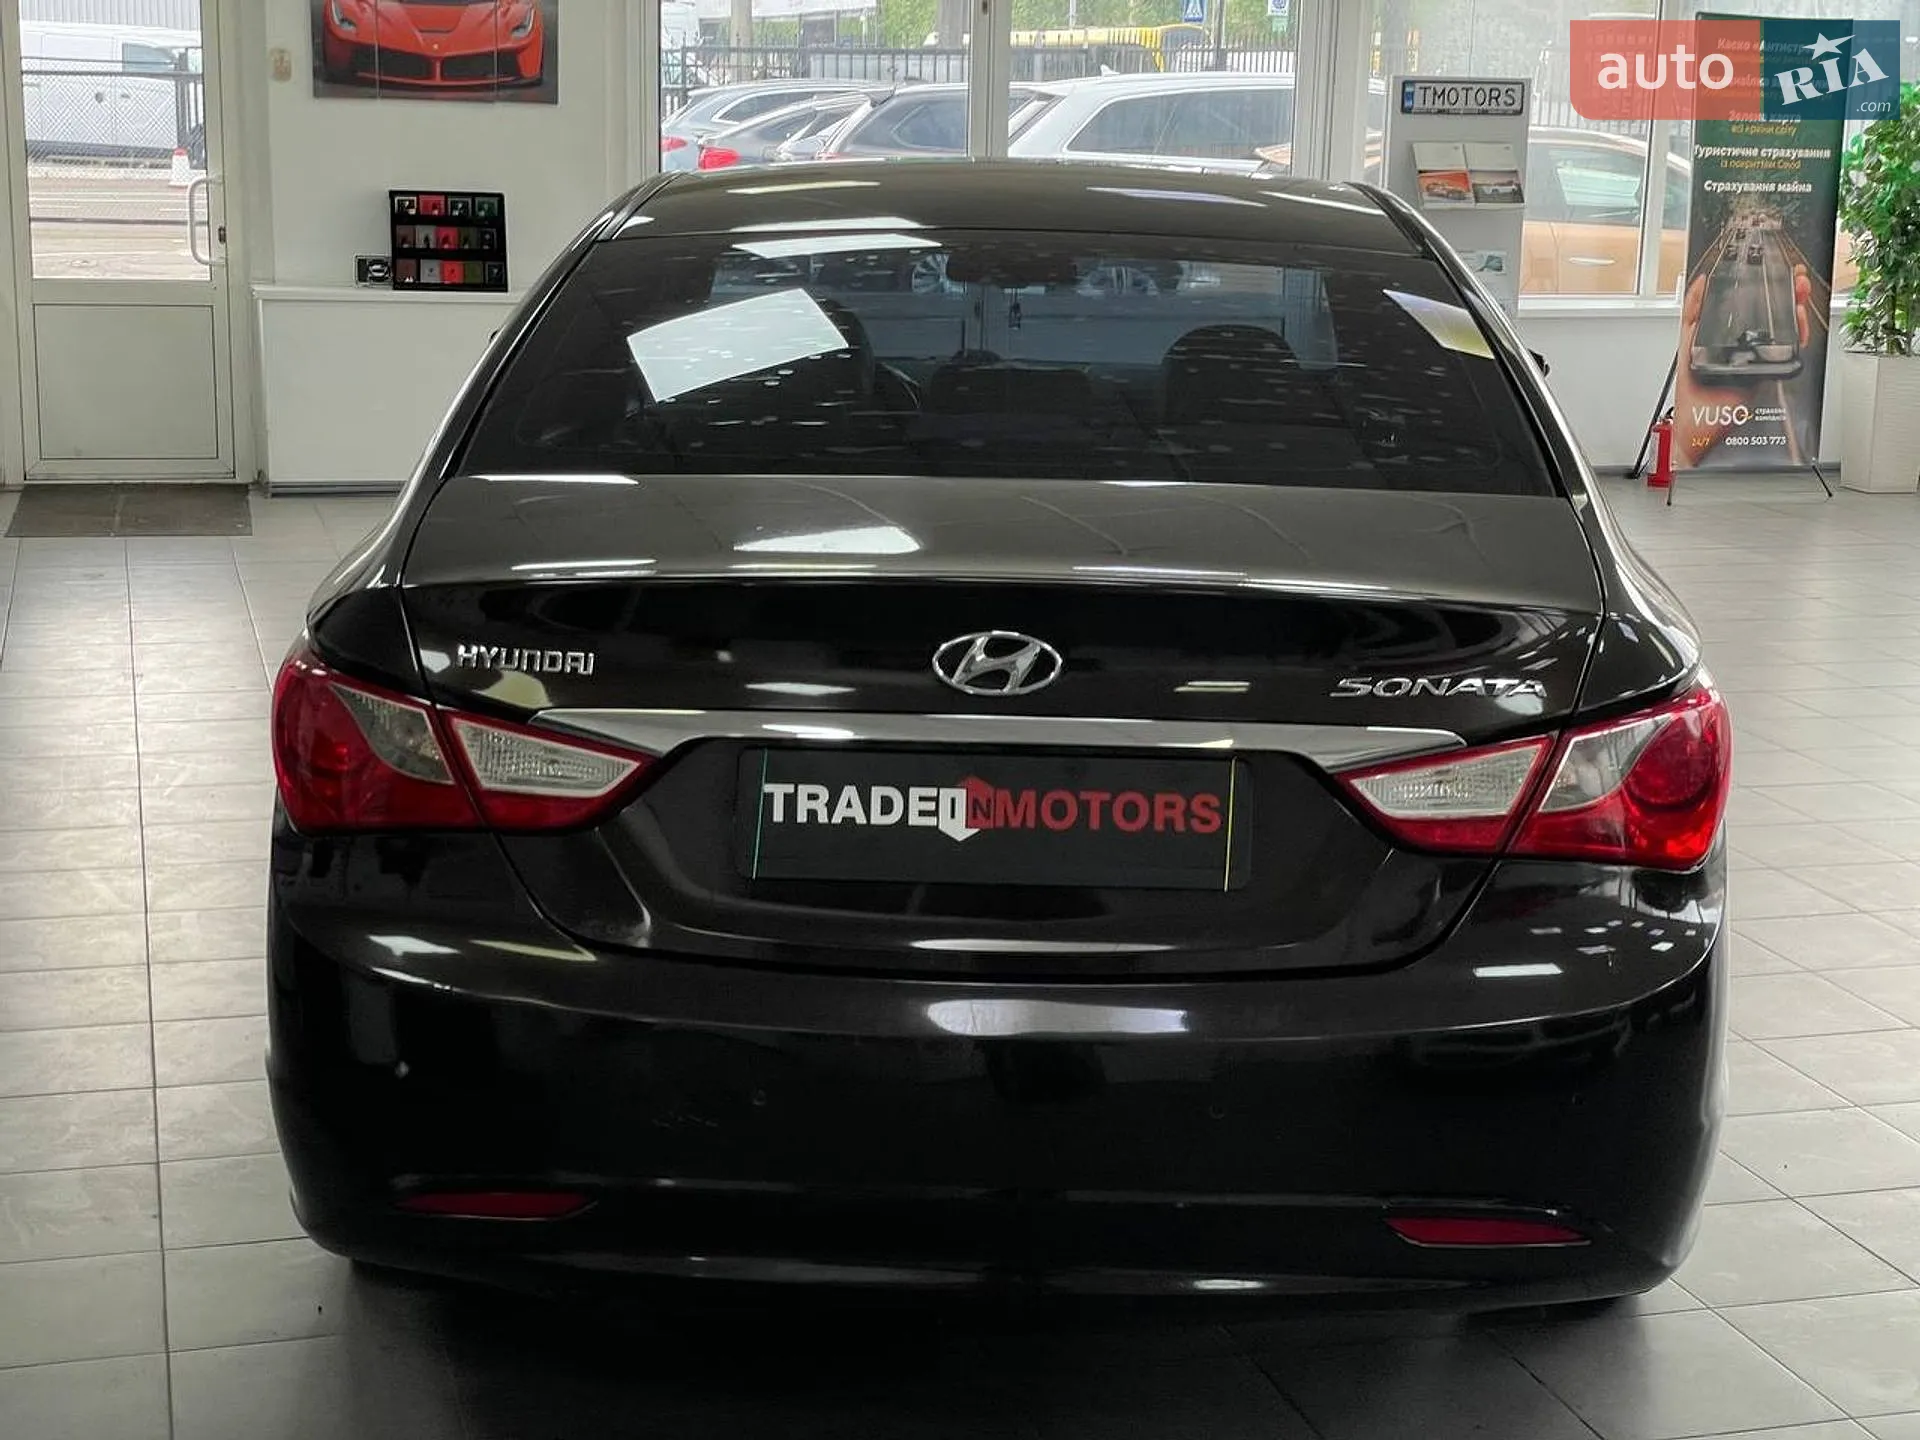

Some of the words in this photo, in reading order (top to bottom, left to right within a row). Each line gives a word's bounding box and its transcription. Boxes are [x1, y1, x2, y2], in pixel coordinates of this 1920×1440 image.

[1419, 86, 1516, 107] TMOTORS
[1703, 180, 1776, 194] Страхування
[1777, 181, 1812, 193] майна
[1692, 405, 1749, 426] VUSO
[457, 644, 595, 676] HYUNDAI
[1329, 676, 1548, 698] SONATA
[763, 784, 938, 827] TRADE
[995, 787, 1222, 834] MOTORS
